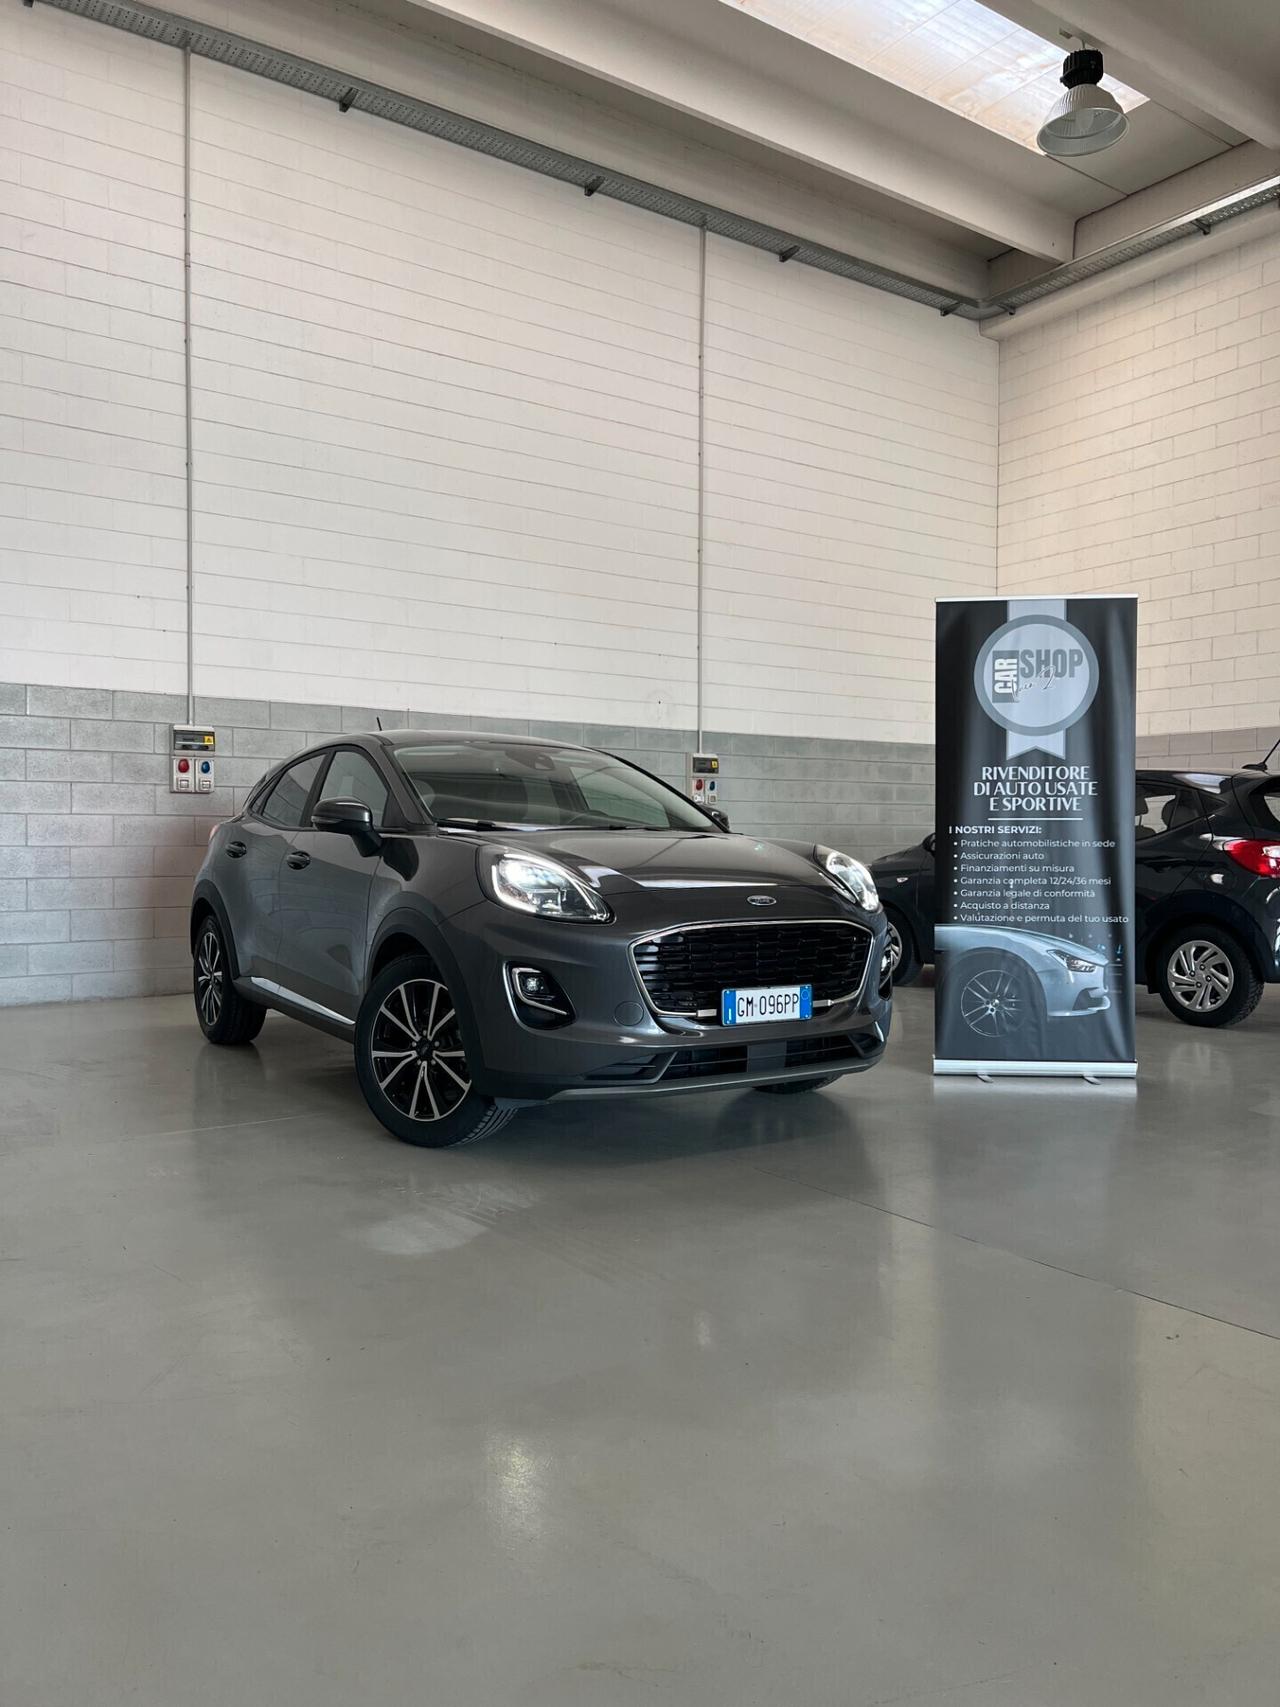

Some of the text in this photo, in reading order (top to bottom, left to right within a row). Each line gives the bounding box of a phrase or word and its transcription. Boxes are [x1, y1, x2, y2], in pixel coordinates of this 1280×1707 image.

[1019, 649, 1083, 678] SHOP
[994, 658, 1017, 694] CAR
[982, 766, 1090, 780] RIVENDITORE
[974, 782, 1098, 795] DI AUTO USATE
[989, 797, 1082, 811] E SPORTIVE
[949, 825, 1042, 834] I NOSTRI SERVIZI:
[960, 839, 1116, 848] Pratiche automobilistiche in sede
[960, 851, 1045, 860] Assicurazioni auto
[960, 864, 1075, 873] Finanziamenti su misura
[960, 876, 1111, 886] Garanzia completa 12/24/36 mesi
[960, 888, 1096, 899] Garanzia legale di conformità
[960, 901, 1001, 911] Acquisto
[1010, 901, 1050, 910] distanza
[960, 913, 1015, 922] Valutazione
[1024, 914, 1066, 924] permuta
[1067, 913, 1083, 922] del
[1084, 914, 1101, 923] tuo
[1102, 914, 1129, 923] usato
[737, 993, 800, 1017] GM 096PP
